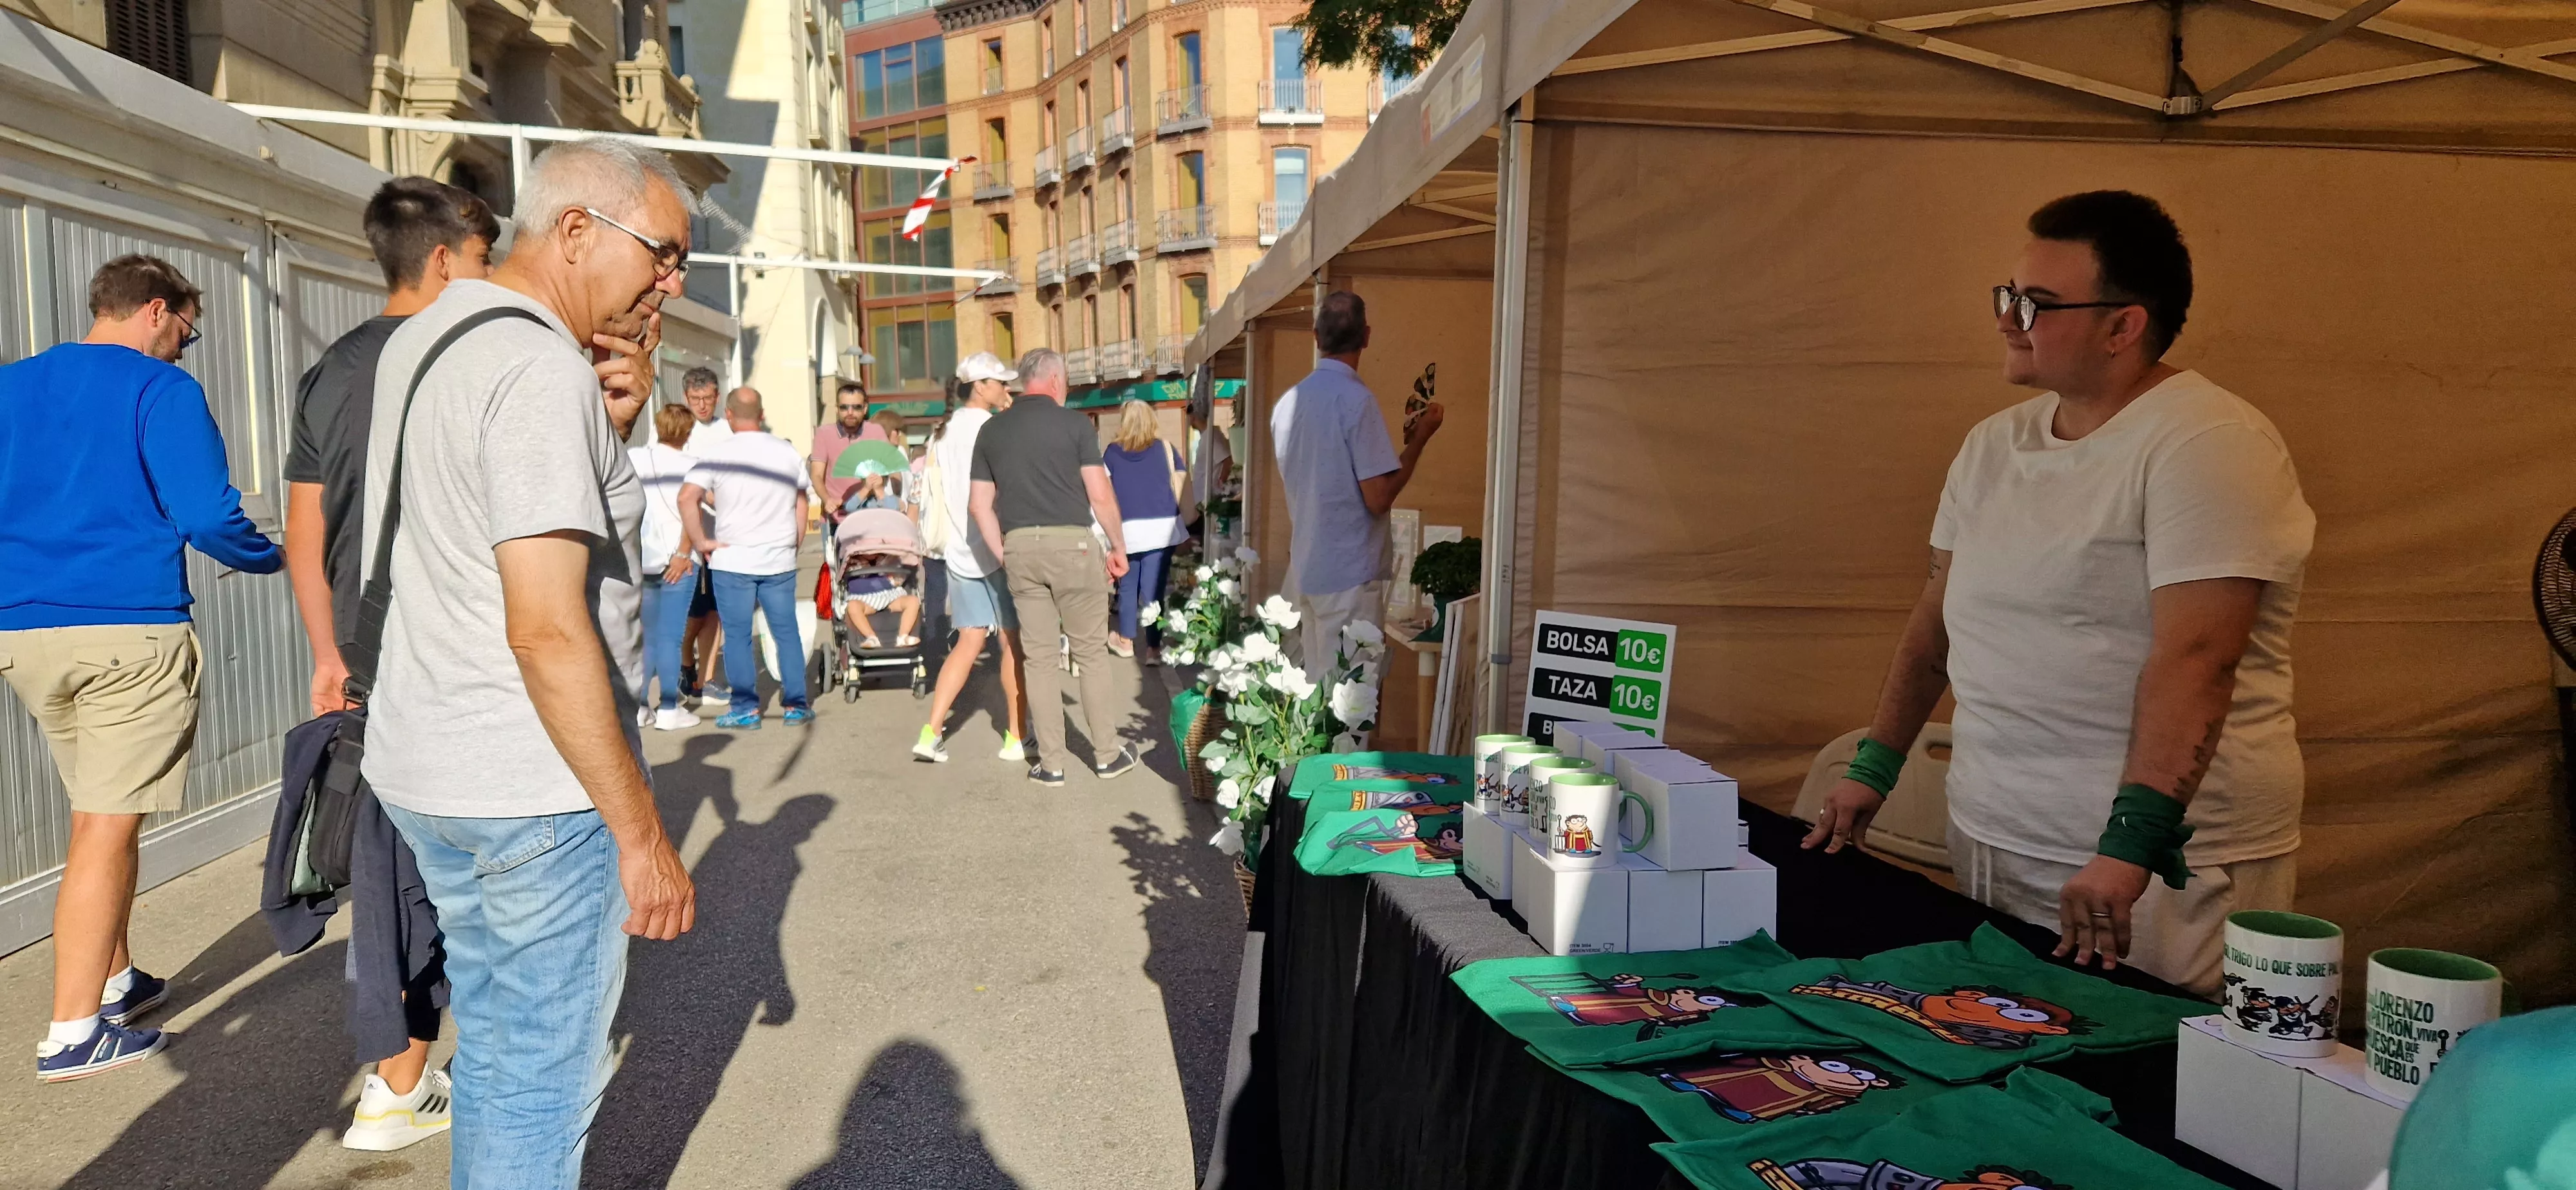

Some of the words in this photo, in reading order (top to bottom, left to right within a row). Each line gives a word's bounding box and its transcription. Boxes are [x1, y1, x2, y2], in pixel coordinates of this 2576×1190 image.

[1546, 630, 1609, 656] BOLSA
[1619, 637, 1661, 664] 10€
[1548, 675, 1598, 701] TAZA
[1613, 683, 1655, 711] 10€
[2255, 956, 2268, 972] LO
[2271, 959, 2293, 976] QUE
[2296, 962, 2326, 978] SOBRE
[2374, 988, 2434, 1024] LORENZO
[2368, 1028, 2405, 1062] UESCA
[2405, 1041, 2420, 1054] QUE
[2417, 1027, 2438, 1043] VIVA
[2374, 1054, 2420, 1085] PUEBLO
[2405, 1052, 2414, 1064] ES
